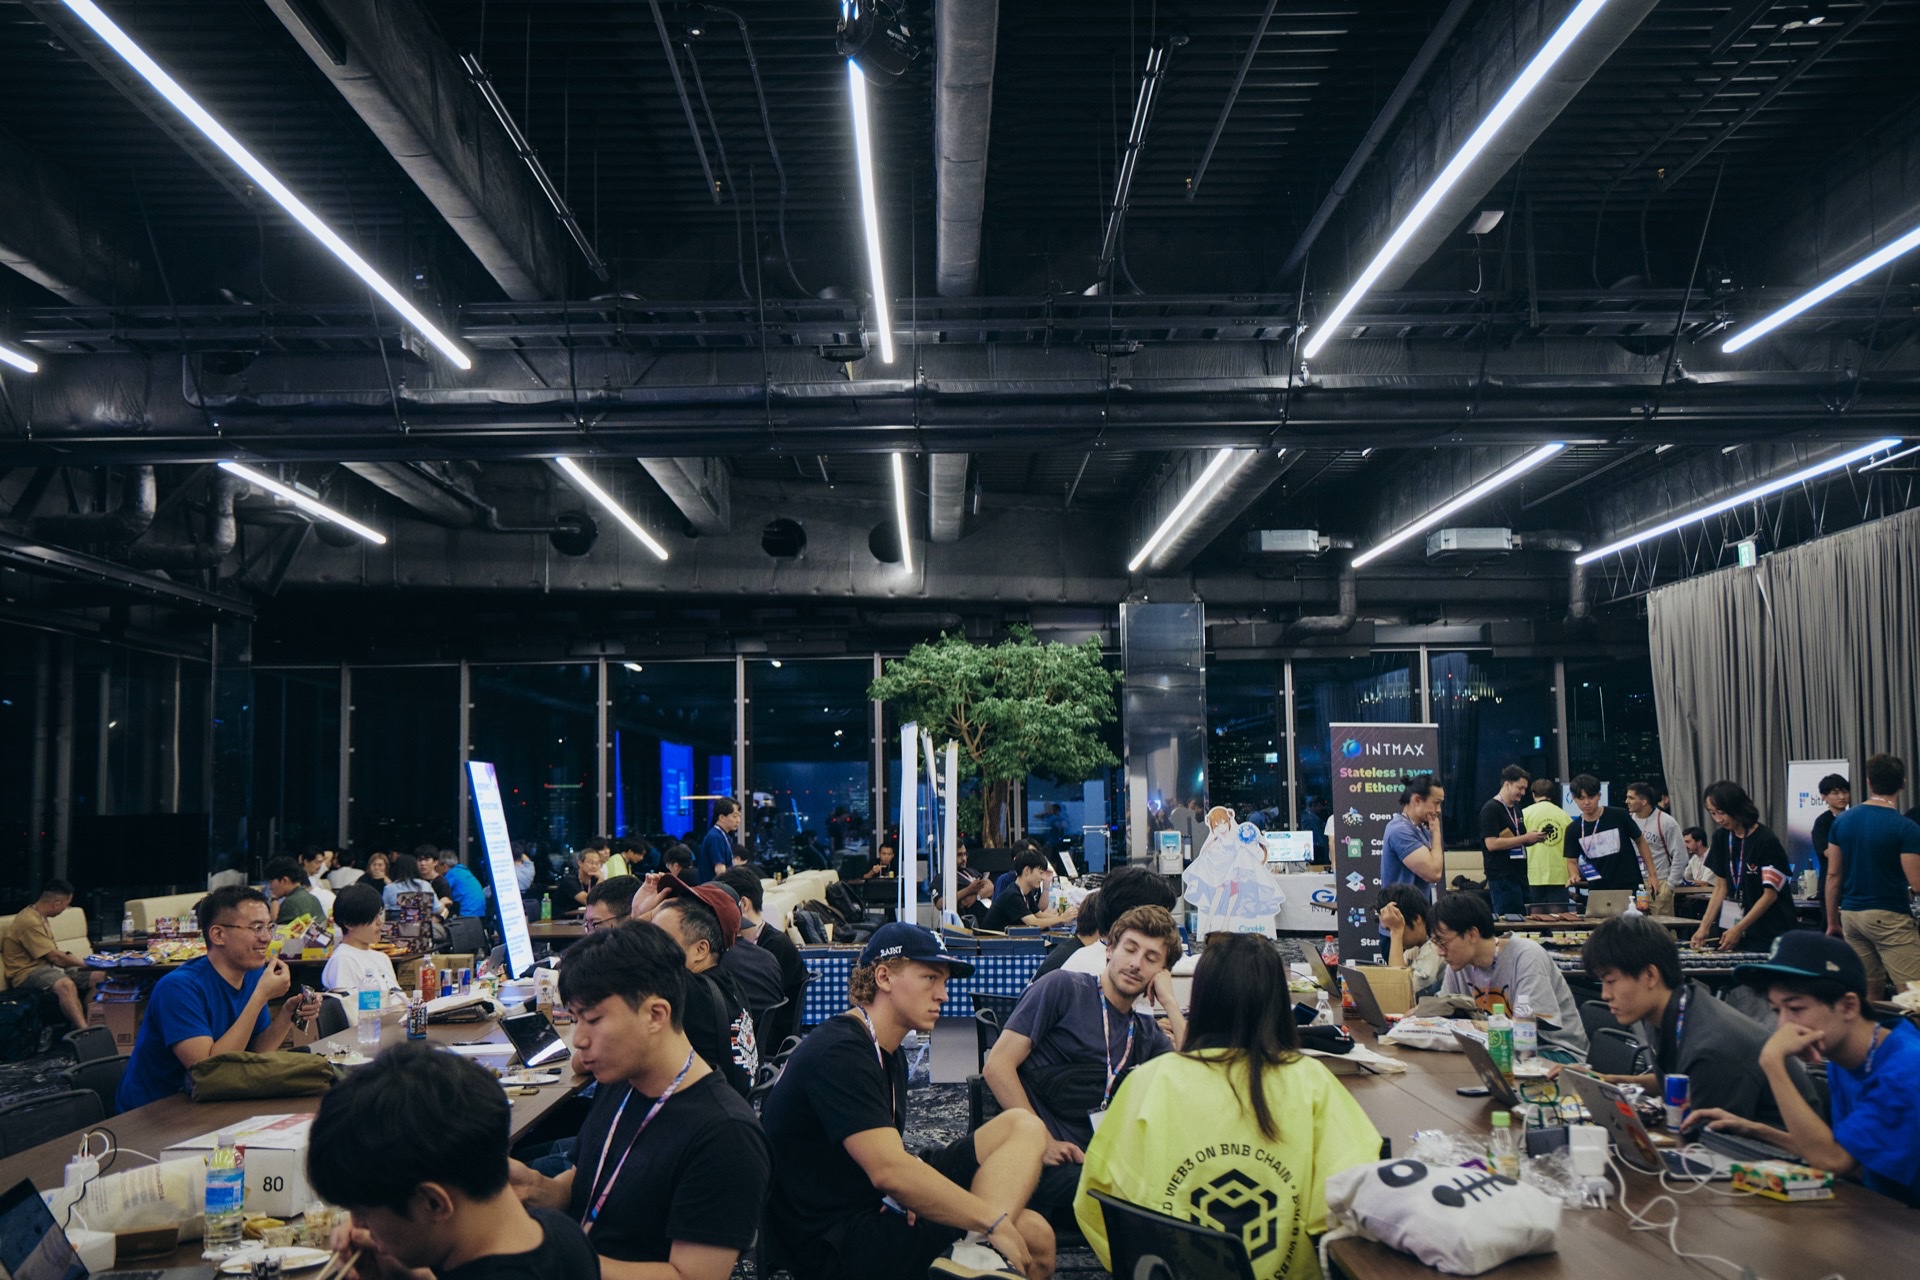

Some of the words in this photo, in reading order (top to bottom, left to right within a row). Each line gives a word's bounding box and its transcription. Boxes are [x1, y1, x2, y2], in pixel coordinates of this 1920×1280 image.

[1365, 742, 1424, 757] INTMAX
[1340, 767, 1396, 778] Stateless
[1349, 782, 1362, 793] of
[1365, 782, 1406, 793] Ethere
[1369, 812, 1391, 821] Open
[1360, 938, 1380, 946] Star
[1165, 1158, 1195, 1197] WEB3
[1195, 1146, 1216, 1163] ON
[1220, 1143, 1251, 1156] BNB
[1255, 1149, 1293, 1184] CHAIN
[262, 1176, 284, 1192] 80
